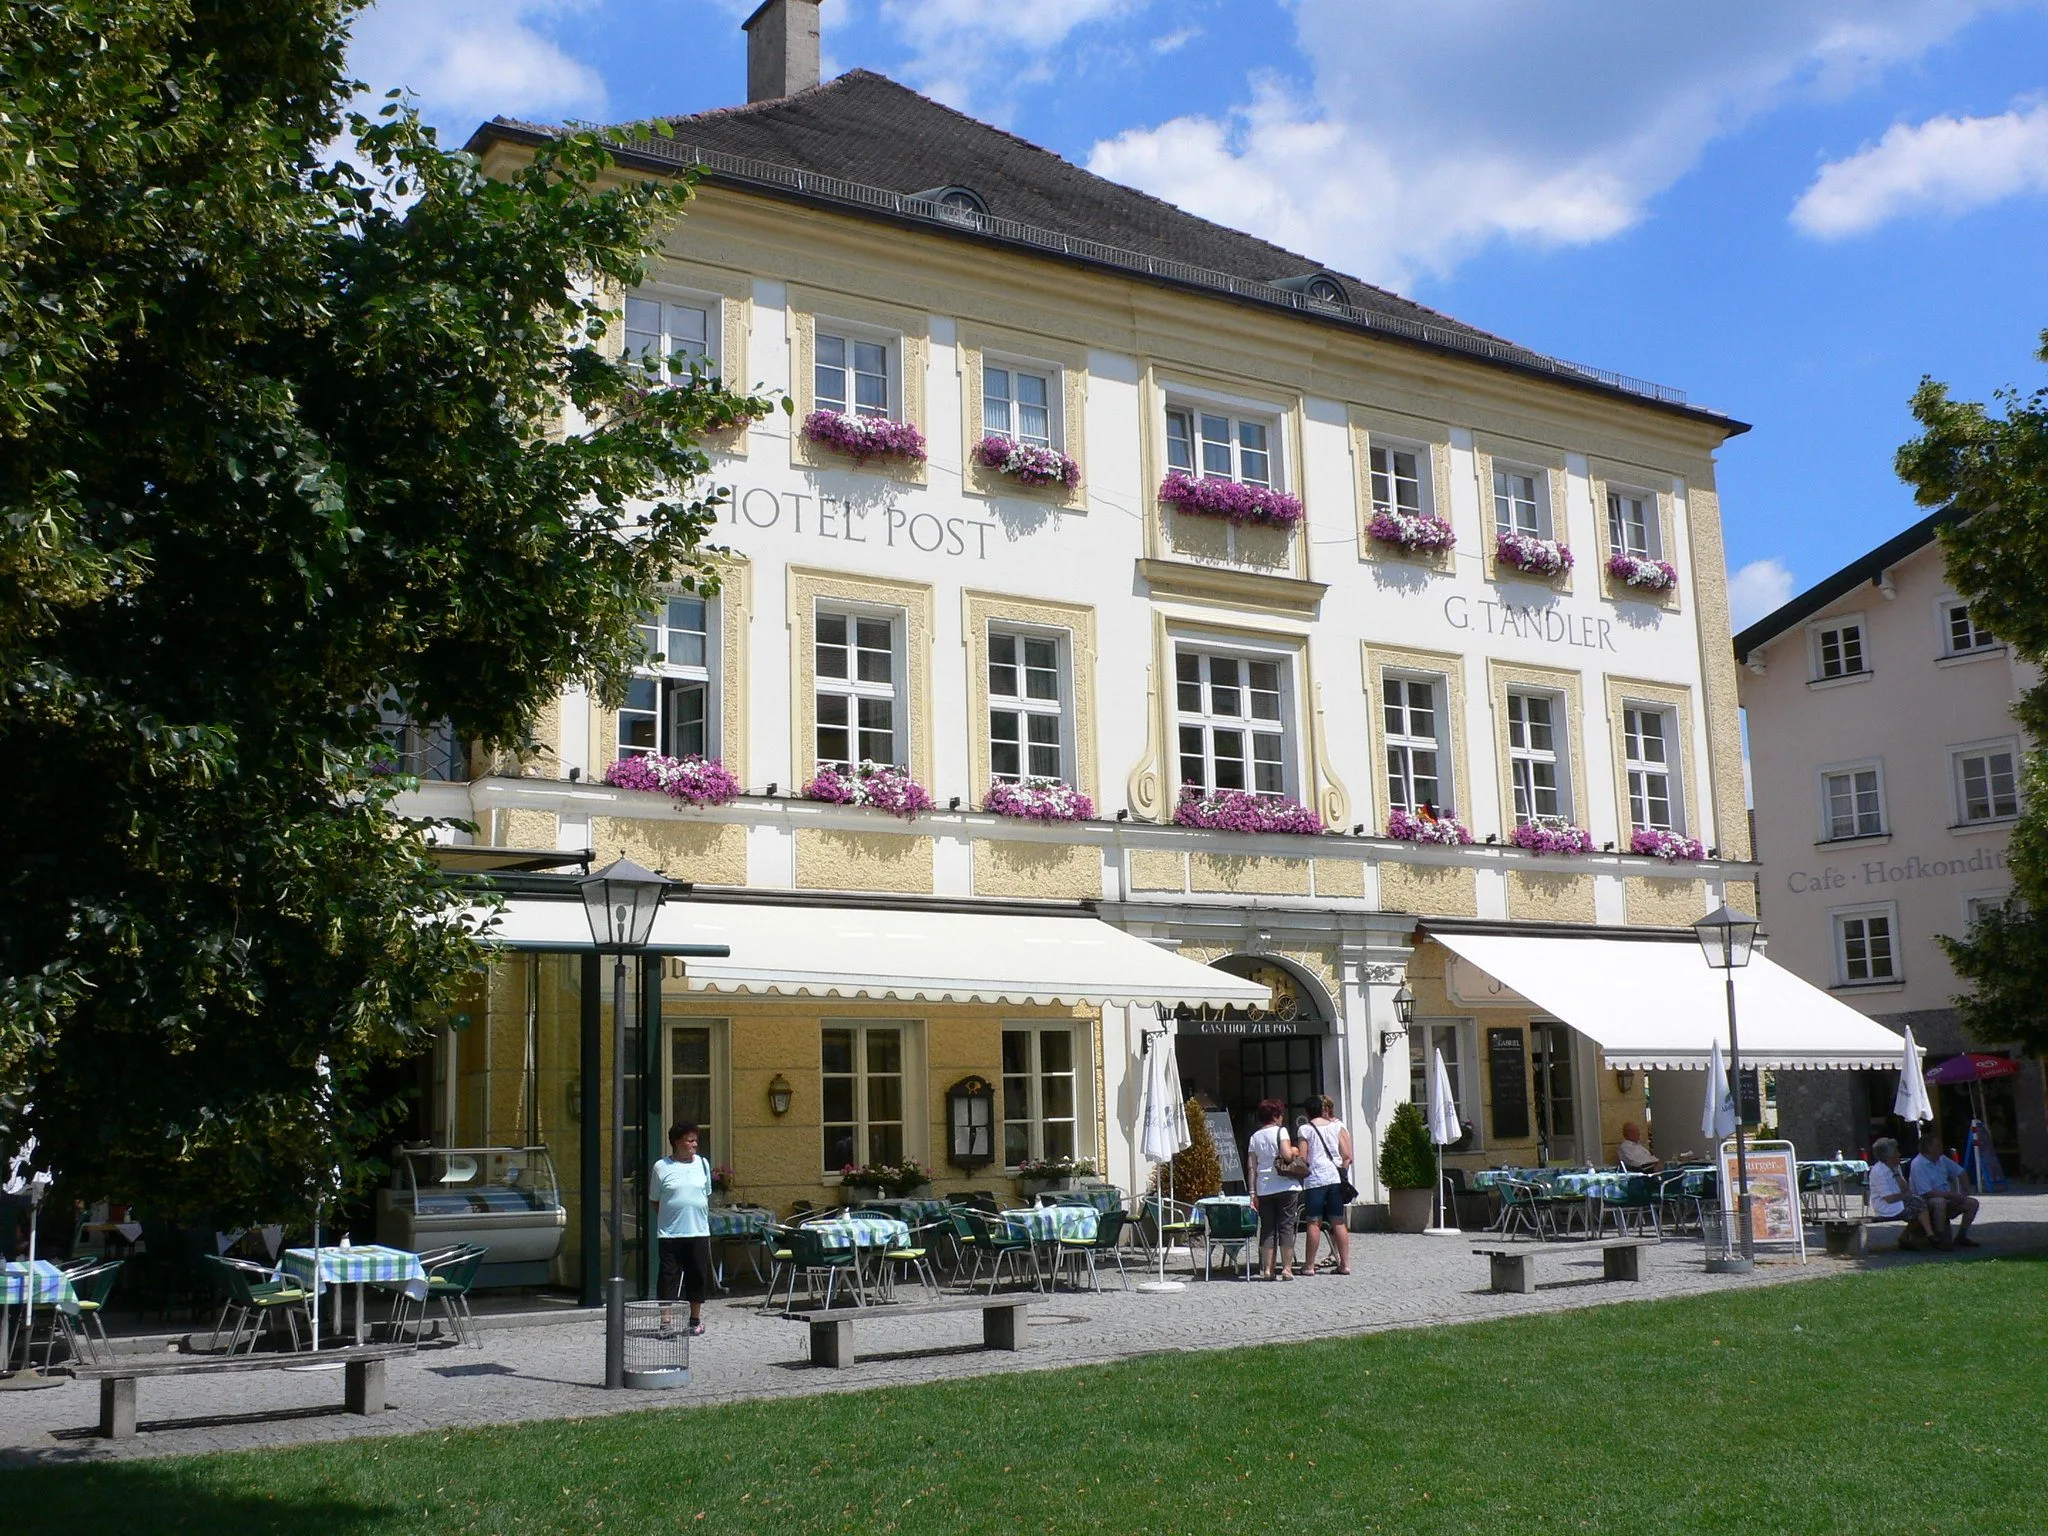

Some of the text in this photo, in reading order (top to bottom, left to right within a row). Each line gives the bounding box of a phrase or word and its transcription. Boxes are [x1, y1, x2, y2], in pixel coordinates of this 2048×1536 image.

[709, 480, 996, 560] HOTEL POST
[1444, 596, 1618, 653] G. TANDLER
[1862, 848, 2008, 885] Hofkondit
[1201, 1023, 1297, 1034] GASTHOF ZUR POST
[1745, 1160, 1777, 1171] urger
